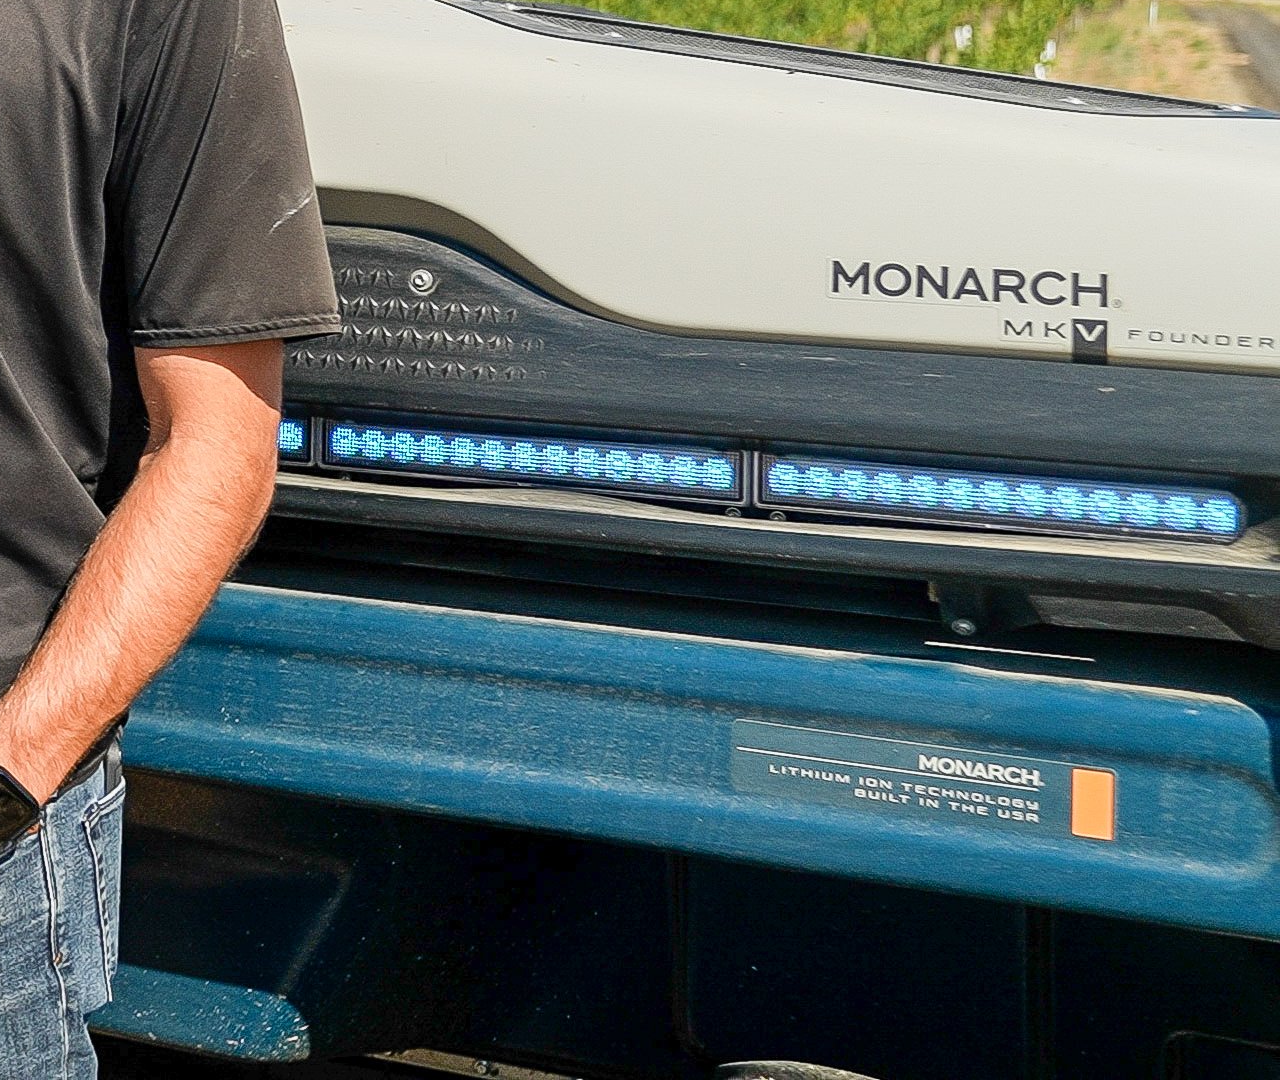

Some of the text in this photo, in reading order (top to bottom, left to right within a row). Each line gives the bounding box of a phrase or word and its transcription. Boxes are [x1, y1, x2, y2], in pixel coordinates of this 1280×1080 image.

[830, 259, 1108, 308] MONARCH
[1127, 329, 1275, 350] FOUNDER
[918, 754, 1042, 787] MONARCH
[768, 764, 1040, 812] LITHIUM ION TECHNOLOGY
[853, 788, 912, 805] BUILT
[918, 797, 940, 810] IN
[947, 801, 990, 817] THE
